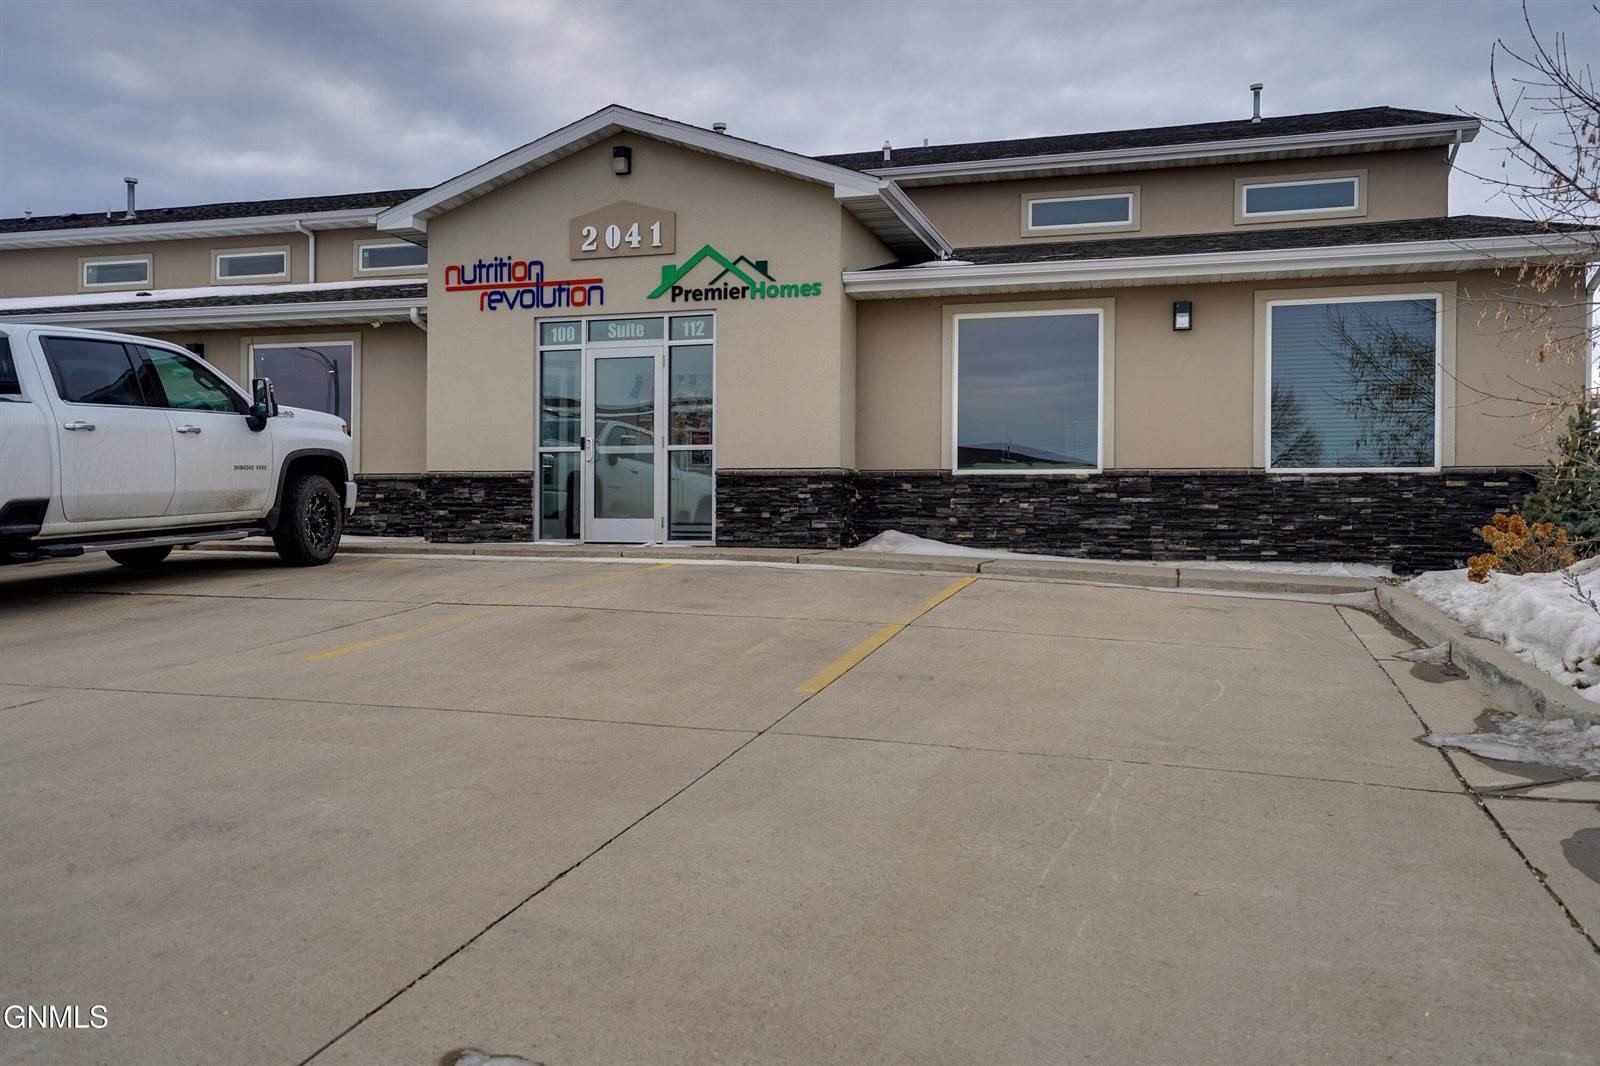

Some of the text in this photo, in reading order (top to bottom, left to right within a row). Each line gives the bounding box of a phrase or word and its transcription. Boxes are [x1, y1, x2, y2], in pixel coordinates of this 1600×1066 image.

[581, 221, 662, 252] 2041
[445, 256, 544, 285] nutrition
[480, 272, 604, 311] revolution
[551, 326, 576, 342] 100
[607, 322, 645, 339] Suite
[682, 320, 705, 337] 112
